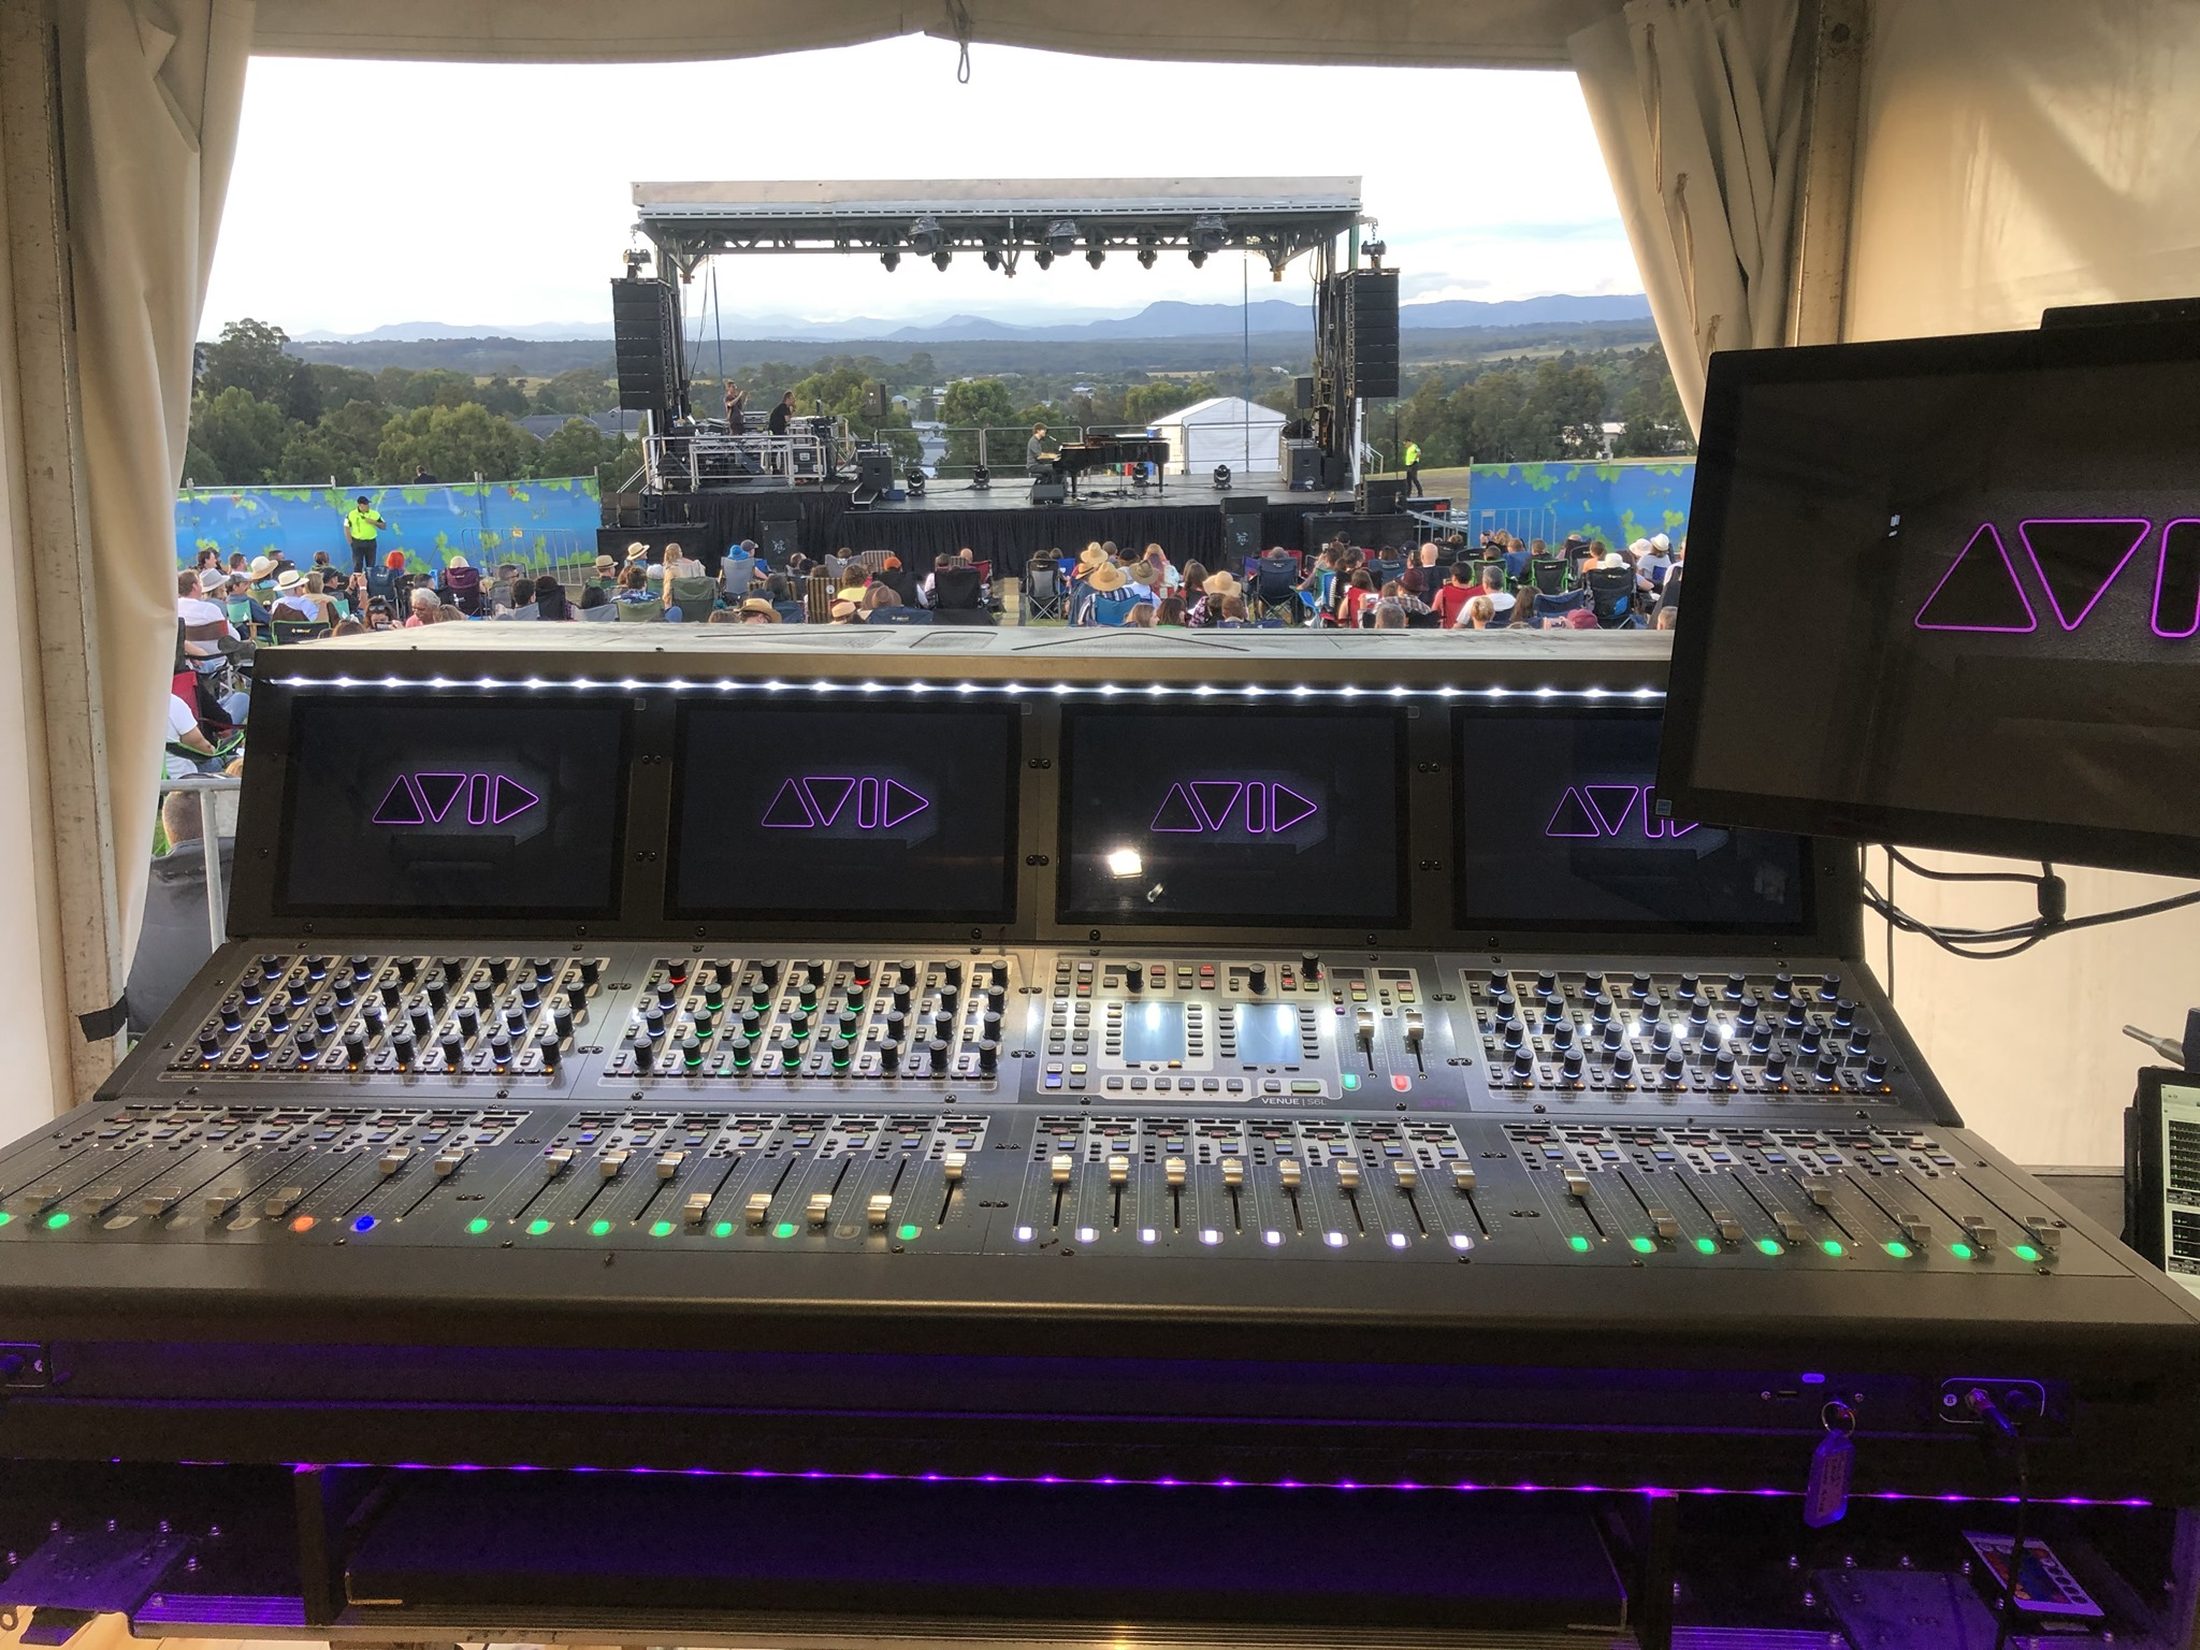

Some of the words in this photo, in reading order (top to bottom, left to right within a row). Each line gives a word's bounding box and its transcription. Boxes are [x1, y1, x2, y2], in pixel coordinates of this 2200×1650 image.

[372, 772, 539, 825] AVID
[761, 776, 930, 829] AVID
[1151, 781, 1317, 833] AVID
[1545, 785, 1699, 838] AVI
[1261, 1097, 1300, 1105] VENUE
